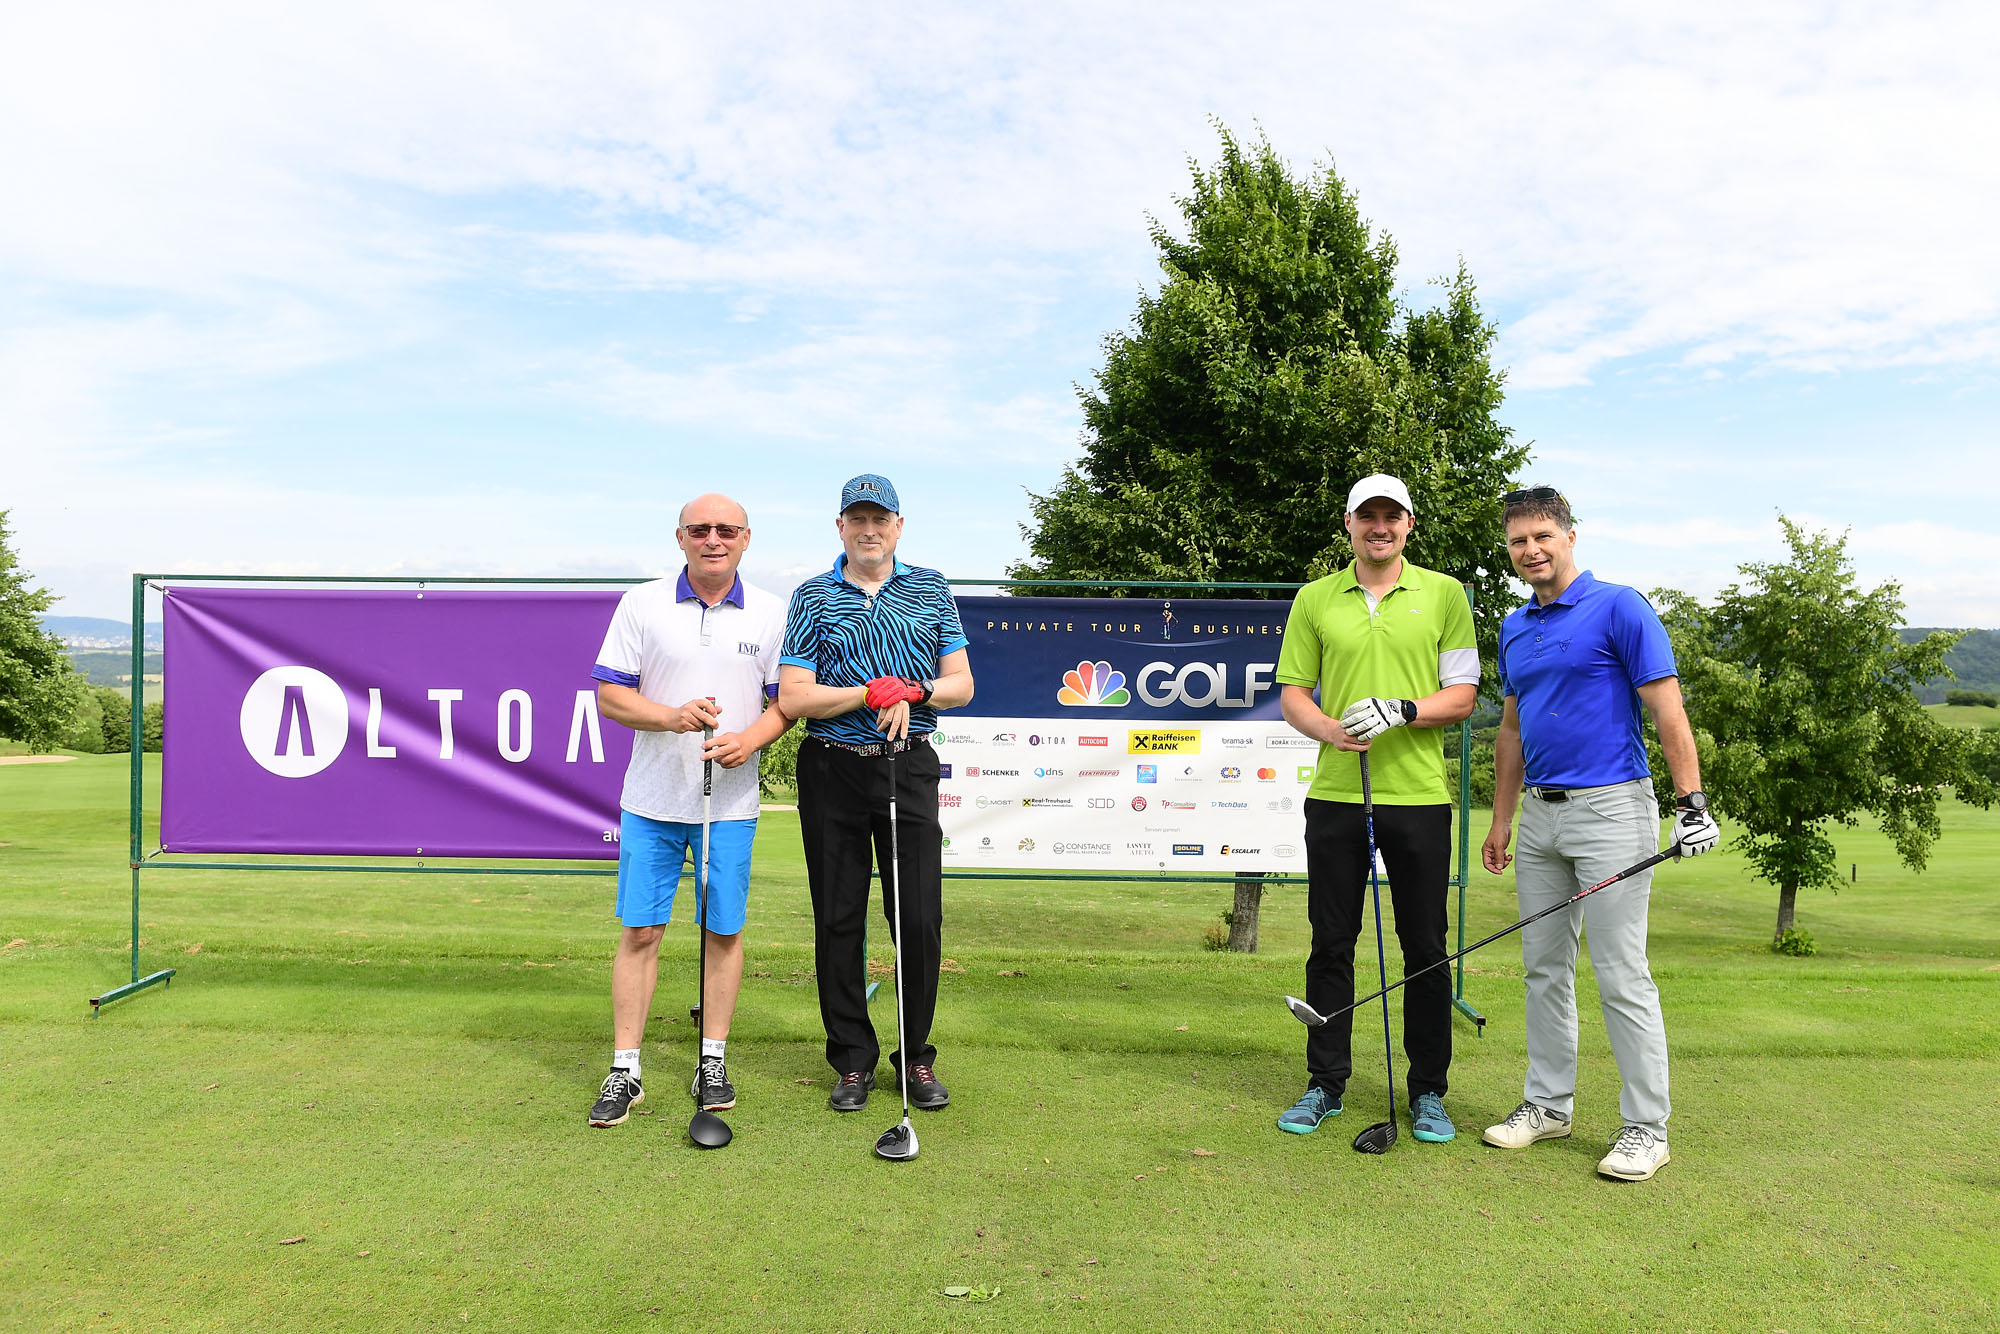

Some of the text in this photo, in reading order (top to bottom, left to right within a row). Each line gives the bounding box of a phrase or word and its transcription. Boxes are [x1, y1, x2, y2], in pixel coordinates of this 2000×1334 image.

[986, 621, 1142, 633] PRIVATE TOUR
[1193, 624, 1283, 635] BUSINES
[738, 641, 760, 657] IMP
[1136, 661, 1276, 708] GOLF
[274, 685, 606, 763] ALTOA
[1151, 733, 1196, 742] Raiffeisen
[1151, 743, 1179, 751] BANK
[967, 768, 1020, 777] DB SCHENKER
[1045, 767, 1064, 777] dns
[938, 793, 962, 802] ffice
[602, 827, 621, 842] al
[1065, 843, 1112, 851] CONSTANCE
